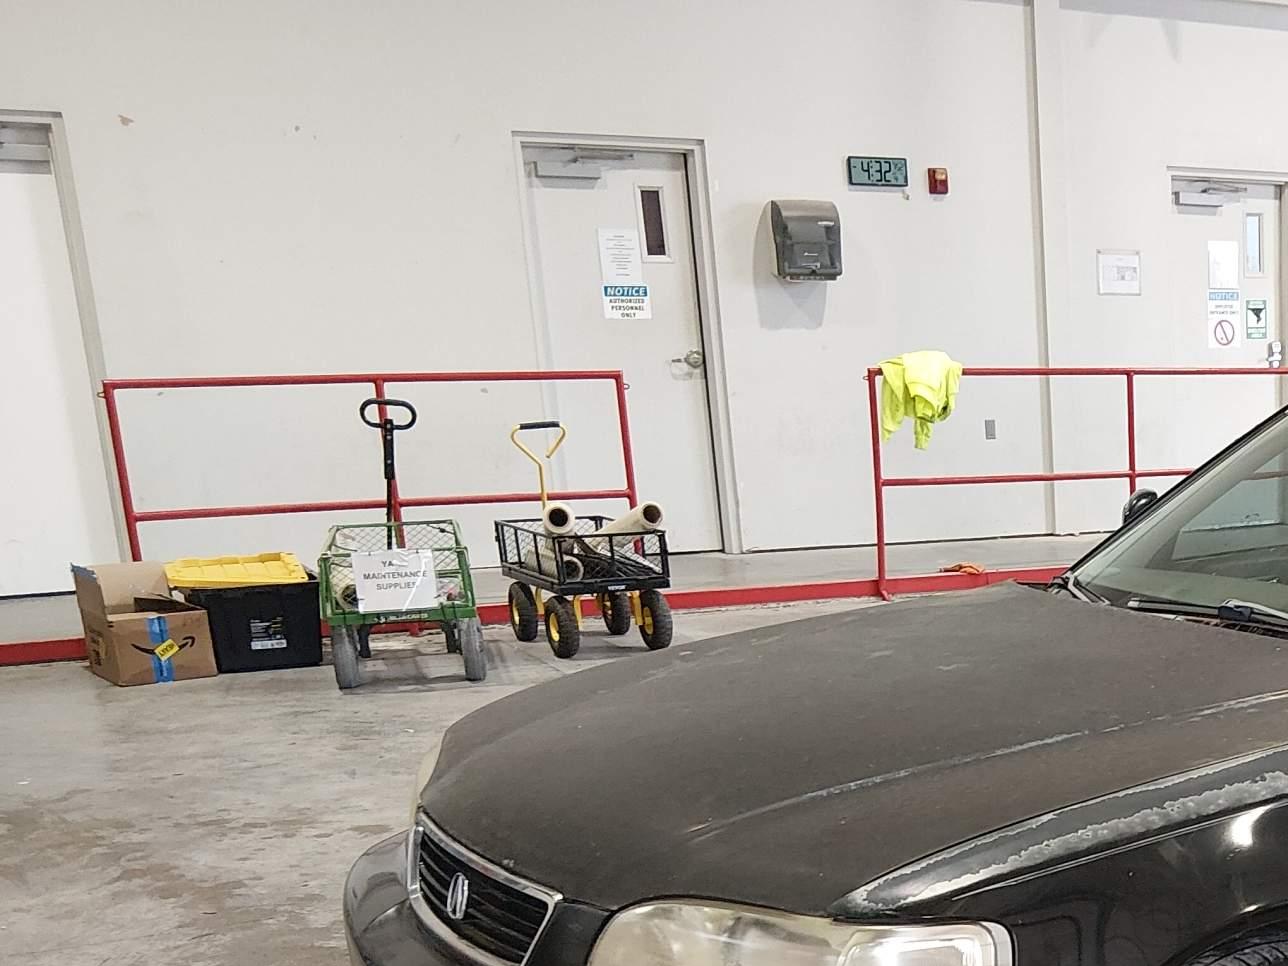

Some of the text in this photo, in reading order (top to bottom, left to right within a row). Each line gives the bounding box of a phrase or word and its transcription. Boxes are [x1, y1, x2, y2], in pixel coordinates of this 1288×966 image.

[861, 160, 892, 182] 4:32
[607, 286, 646, 296] NOTICE
[363, 570, 428, 580] MAINTENANCE
